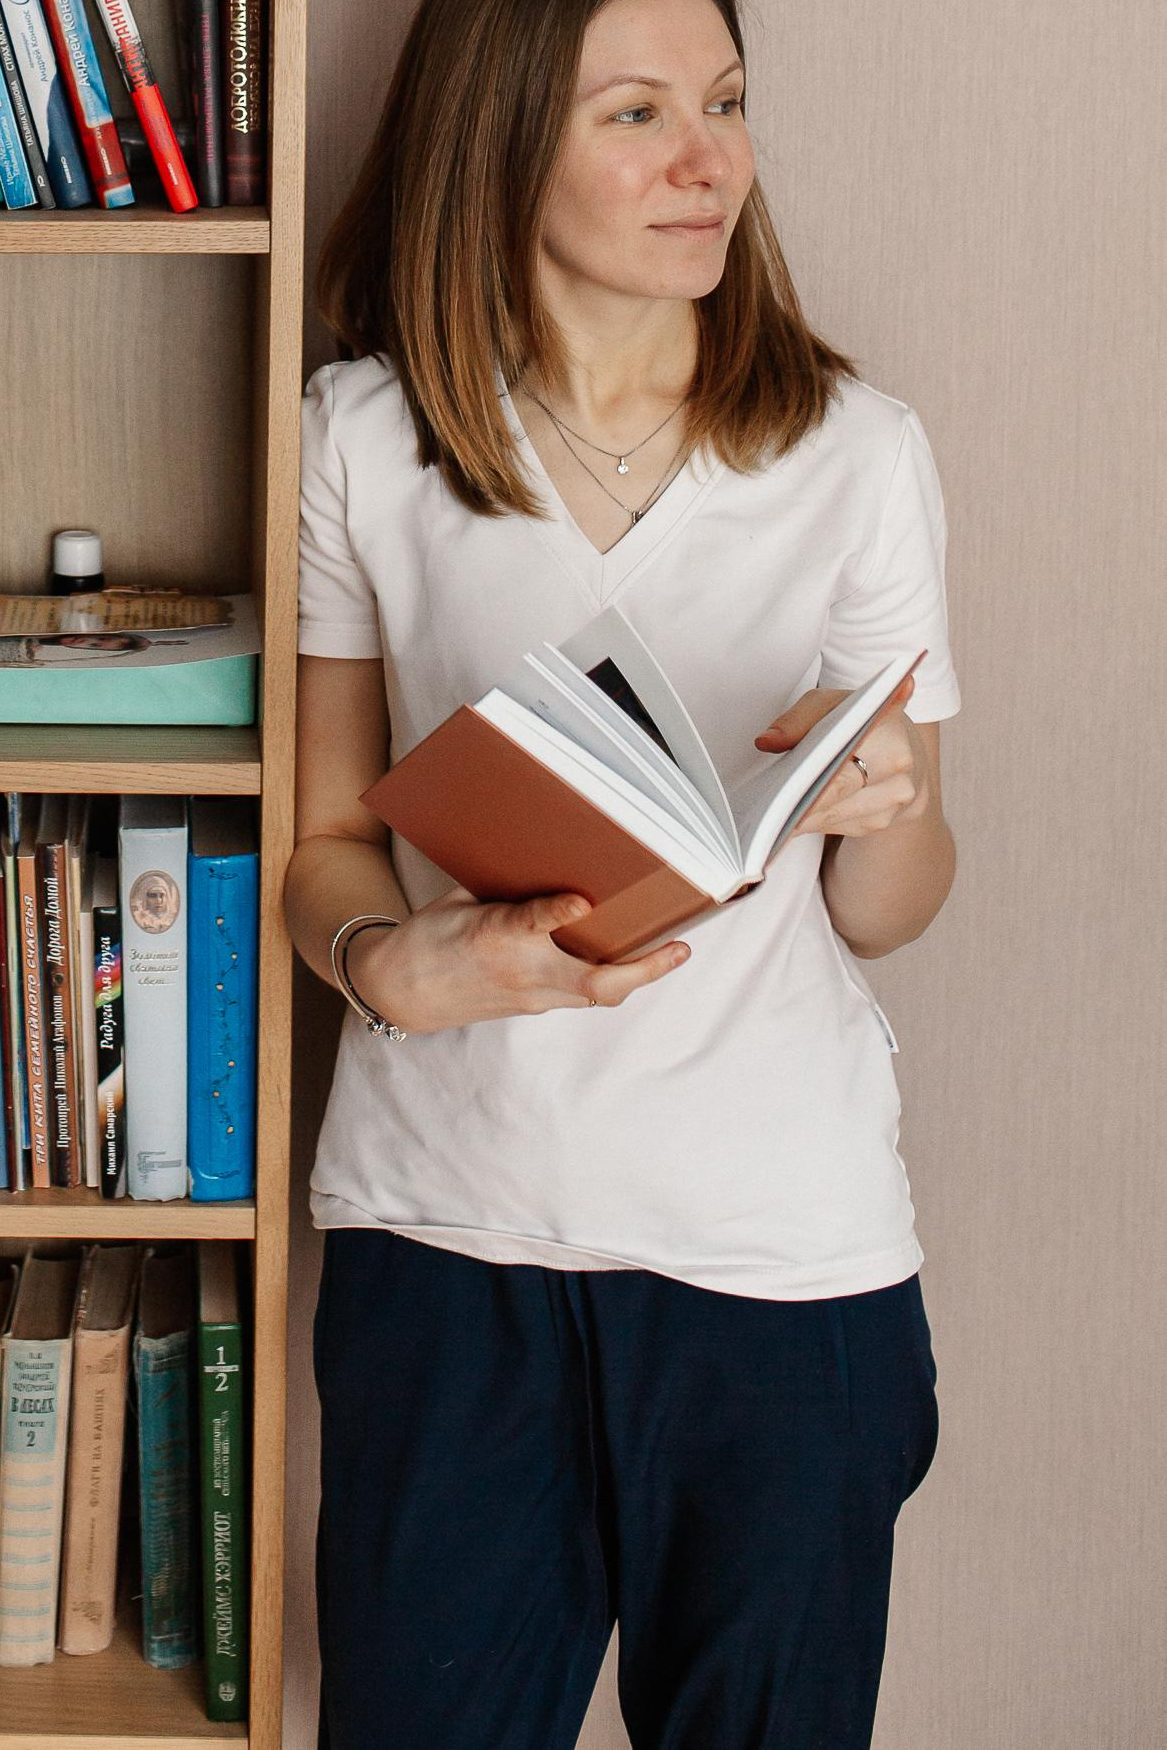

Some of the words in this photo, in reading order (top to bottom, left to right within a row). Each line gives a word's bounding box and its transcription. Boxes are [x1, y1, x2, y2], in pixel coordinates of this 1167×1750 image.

[65, 31, 91, 88] Андрей
[42, 876, 61, 918] Домой
[23, 893, 37, 969] СЧАСТЬЯ
[46, 920, 66, 966] Дорога
[97, 935, 116, 974] друга
[99, 976, 113, 1003] для
[26, 974, 42, 1076] СЕМЕЙНОГО
[100, 1003, 121, 1050] Радуга
[32, 1082, 44, 1128] КИТА
[105, 1090, 118, 1140] Самарский
[35, 1134, 46, 1165] ТРИ
[106, 1141, 118, 1176] Михаил
[213, 1511, 232, 1582] ХЭРРИОТ
[212, 1586, 237, 1656] ДЖЕЙМС
